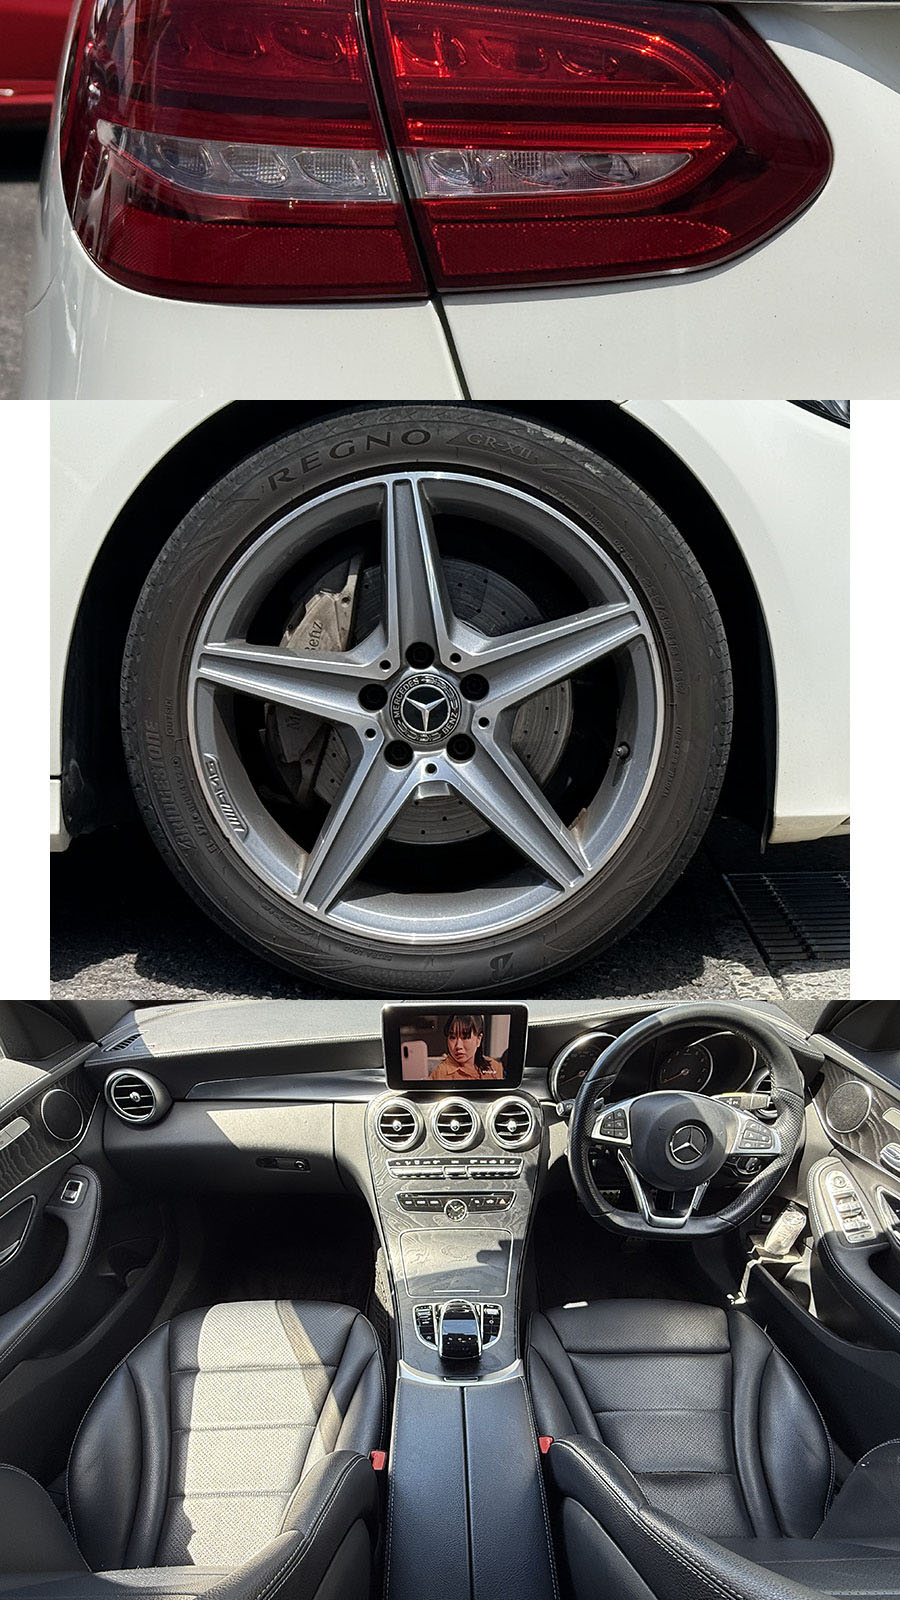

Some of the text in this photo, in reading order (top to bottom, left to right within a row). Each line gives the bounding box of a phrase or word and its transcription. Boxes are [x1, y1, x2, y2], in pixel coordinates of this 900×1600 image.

[267, 429, 431, 492] REGNO
[393, 678, 420, 719] MERCEDES
[442, 712, 458, 735] BENZ
